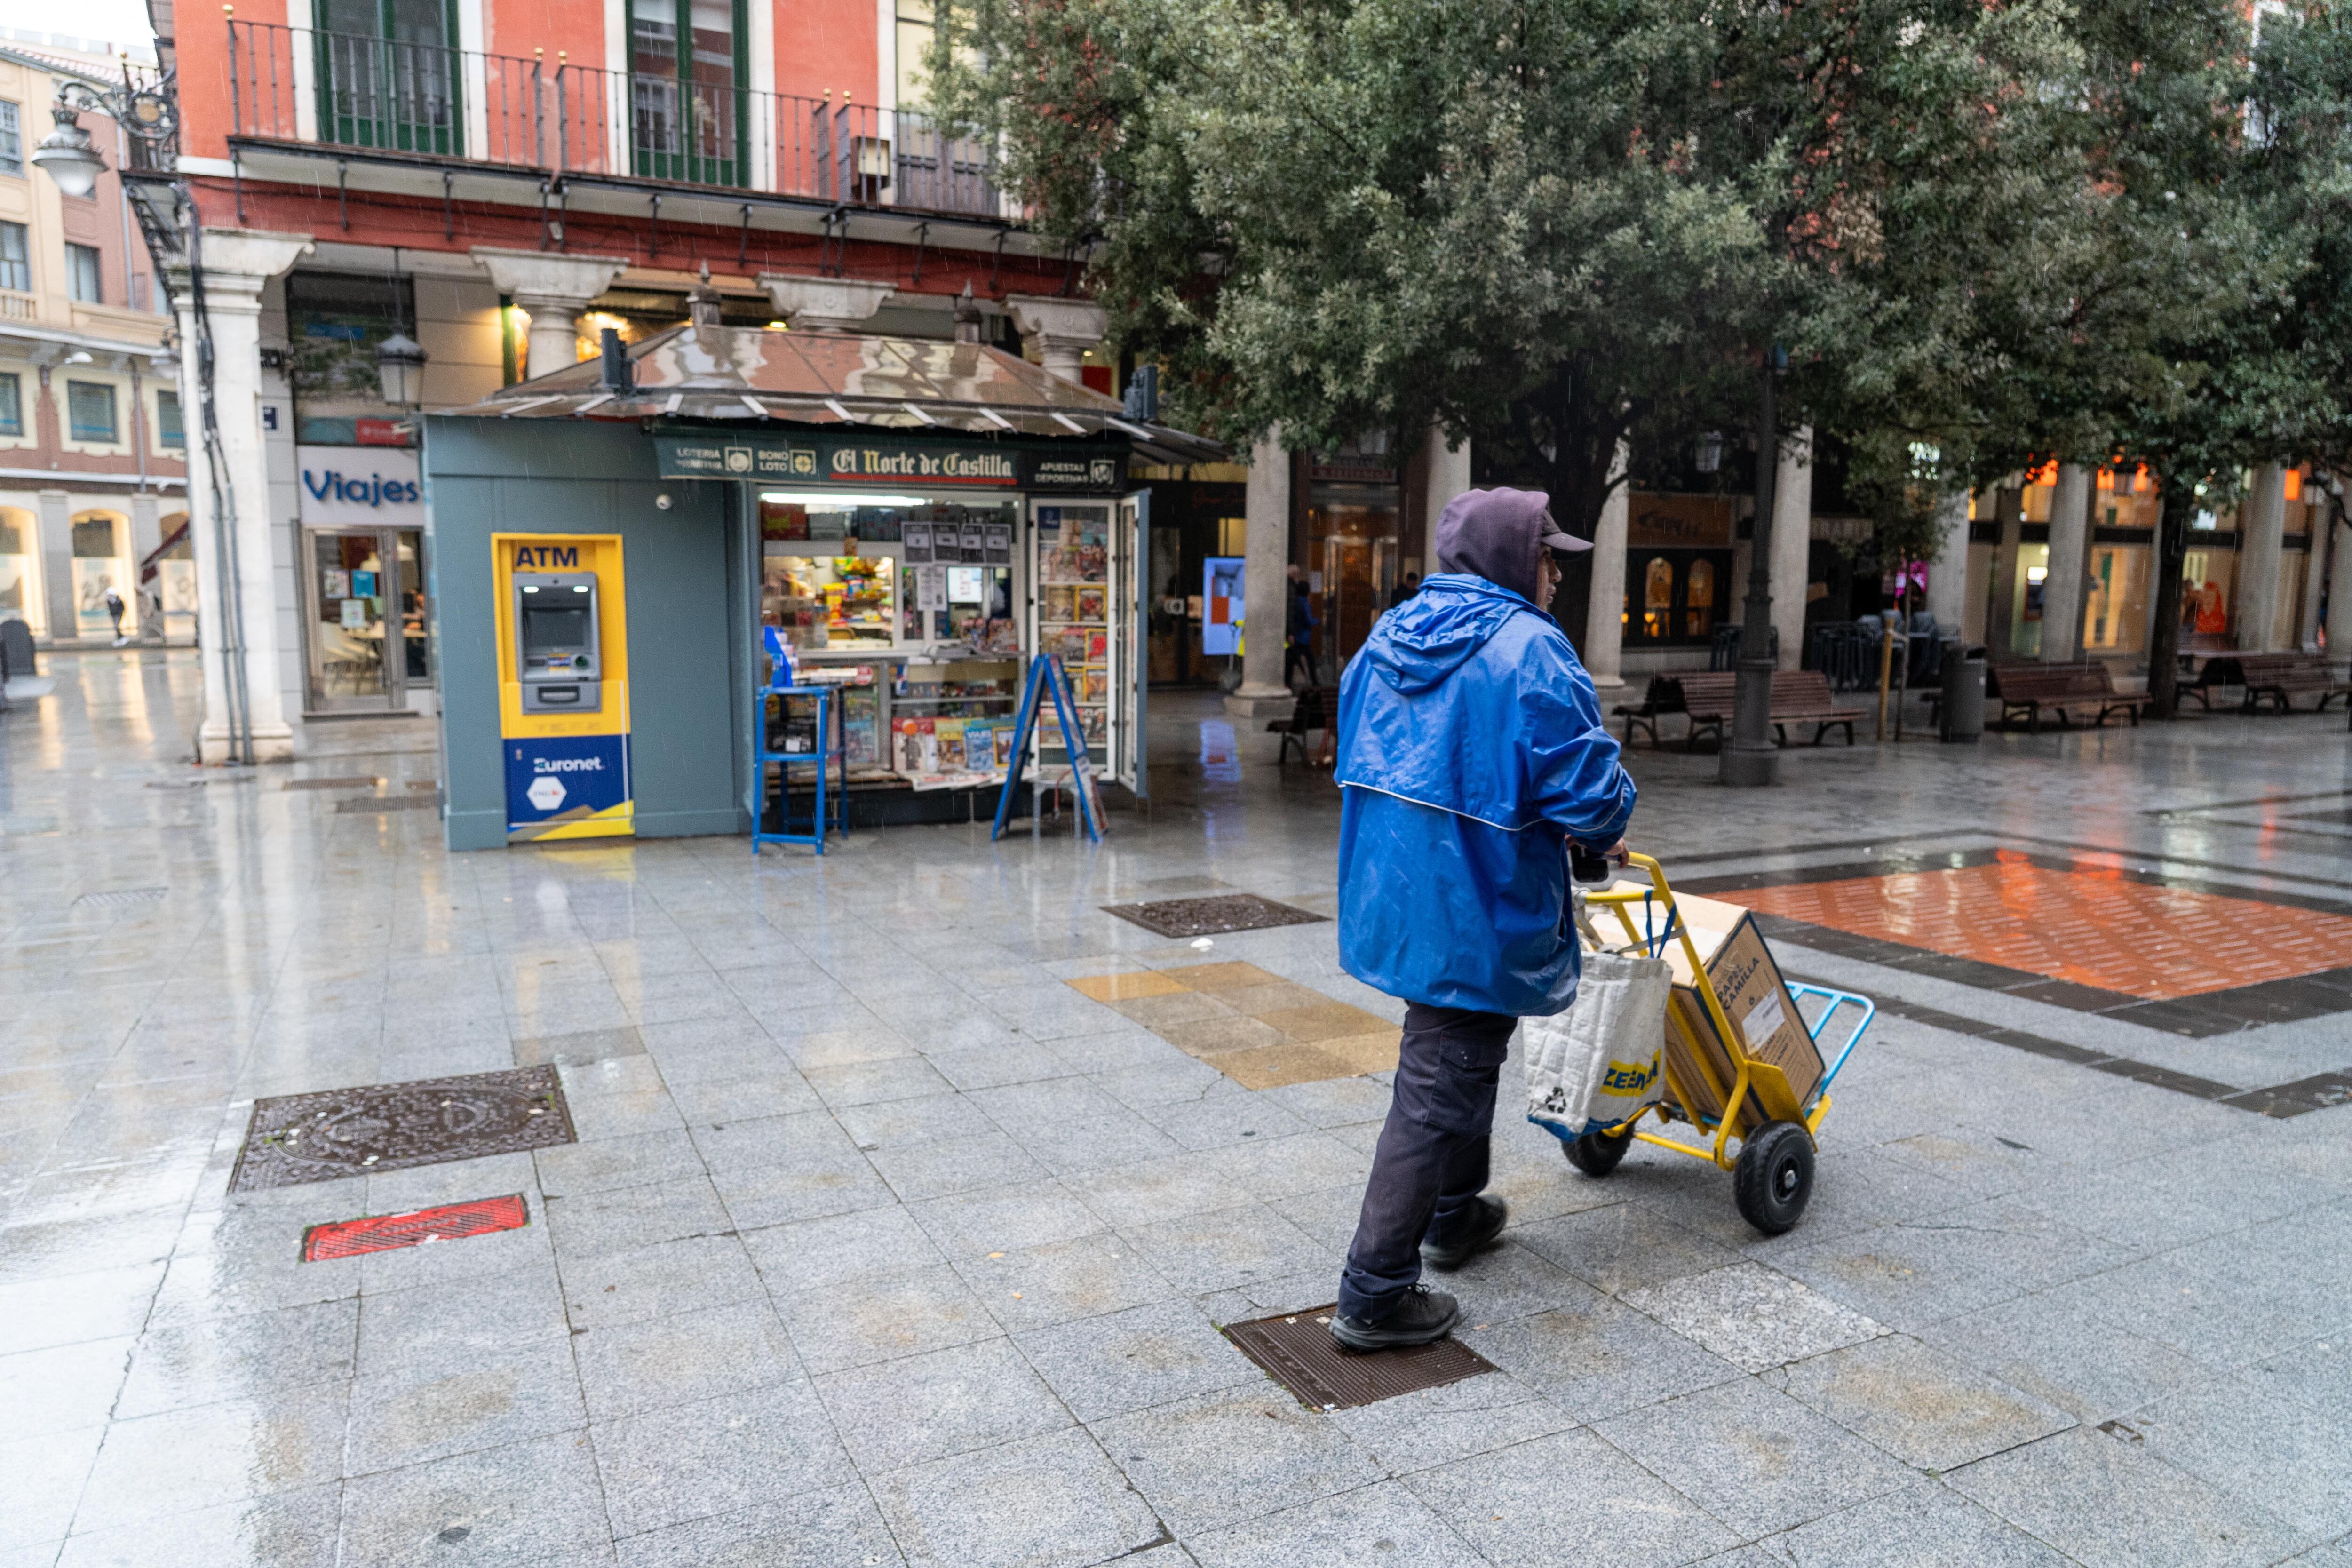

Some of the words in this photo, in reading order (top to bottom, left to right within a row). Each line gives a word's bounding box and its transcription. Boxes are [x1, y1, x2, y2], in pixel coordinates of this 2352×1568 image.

[758, 450, 789, 461] BONO
[832, 448, 857, 473] El
[863, 449, 916, 474] Norte
[919, 453, 940, 475] de
[943, 452, 1012, 477] Castilla
[759, 461, 788, 471] LOTO
[1040, 462, 1085, 472] APUESTAS
[1035, 473, 1089, 483] DEPORTIVAS
[303, 470, 419, 508] Viajes
[516, 547, 578, 567] ATM
[533, 756, 602, 773] Euronet
[1717, 964, 1743, 1002] PAPEL
[1723, 957, 1759, 1010] CAMILLA
